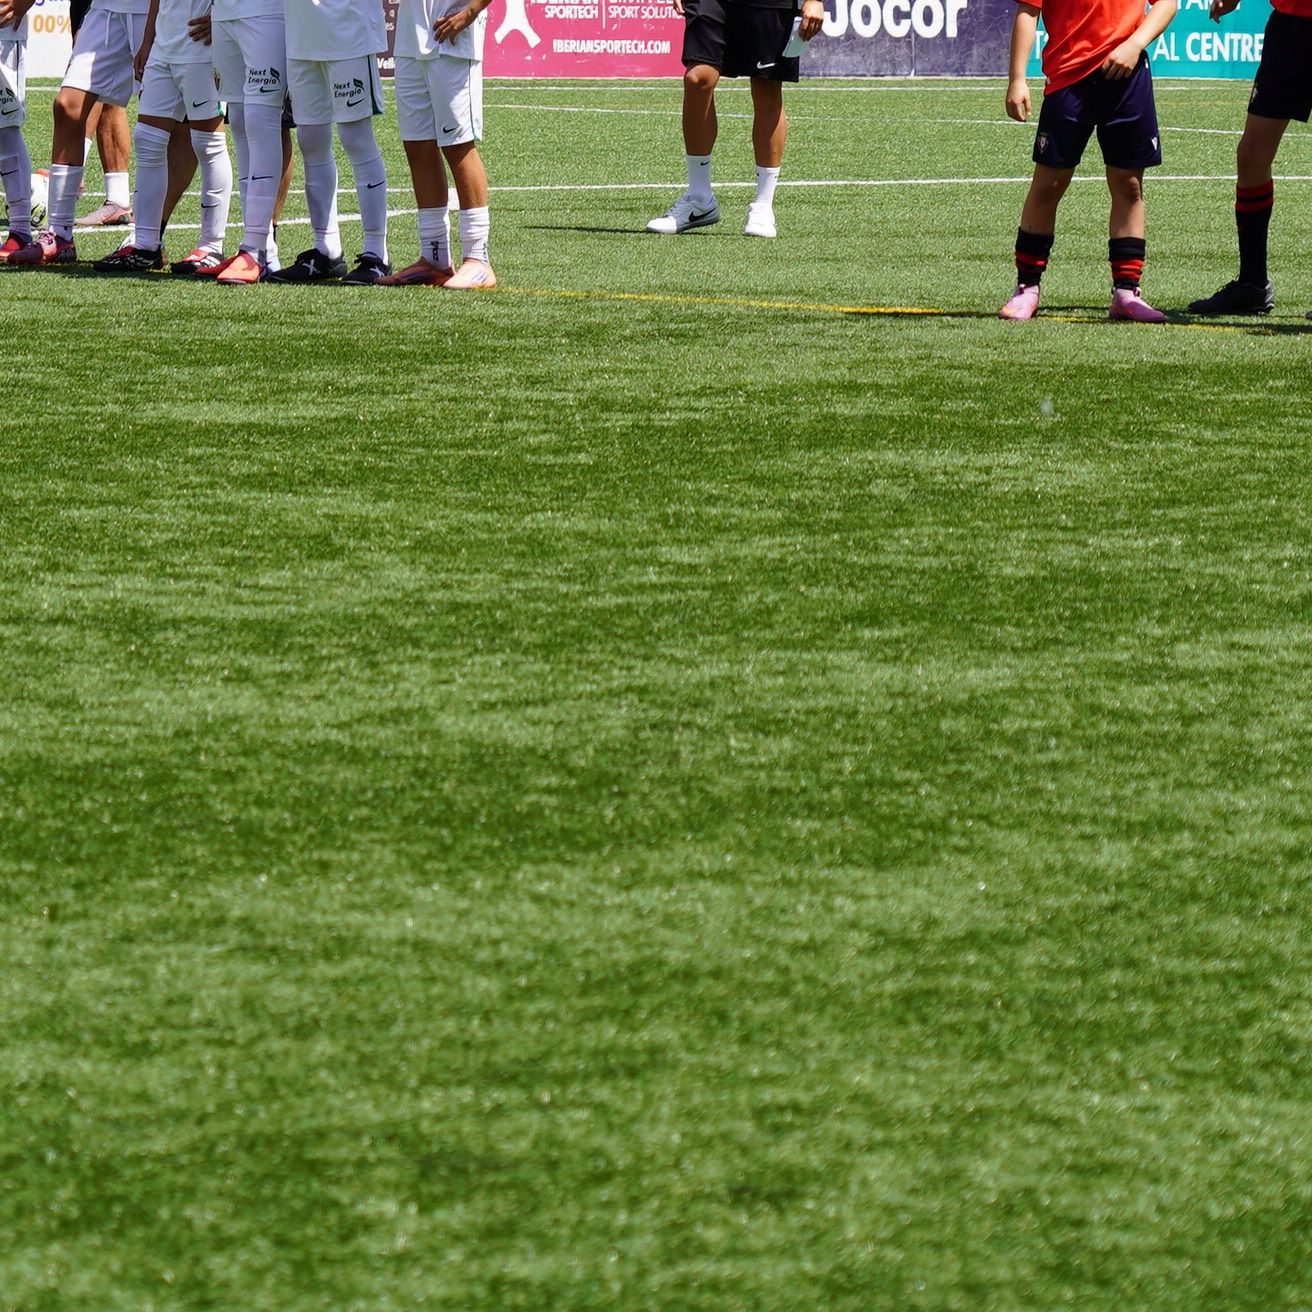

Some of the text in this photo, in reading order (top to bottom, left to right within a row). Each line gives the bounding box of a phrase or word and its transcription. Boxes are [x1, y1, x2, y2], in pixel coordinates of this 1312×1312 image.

[545, 5, 599, 19] SPORTECH
[608, 6, 639, 19] SPORT
[553, 39, 671, 54] IBERIANSPORTECH.COM
[1153, 32, 1264, 62] AL CENTRE
